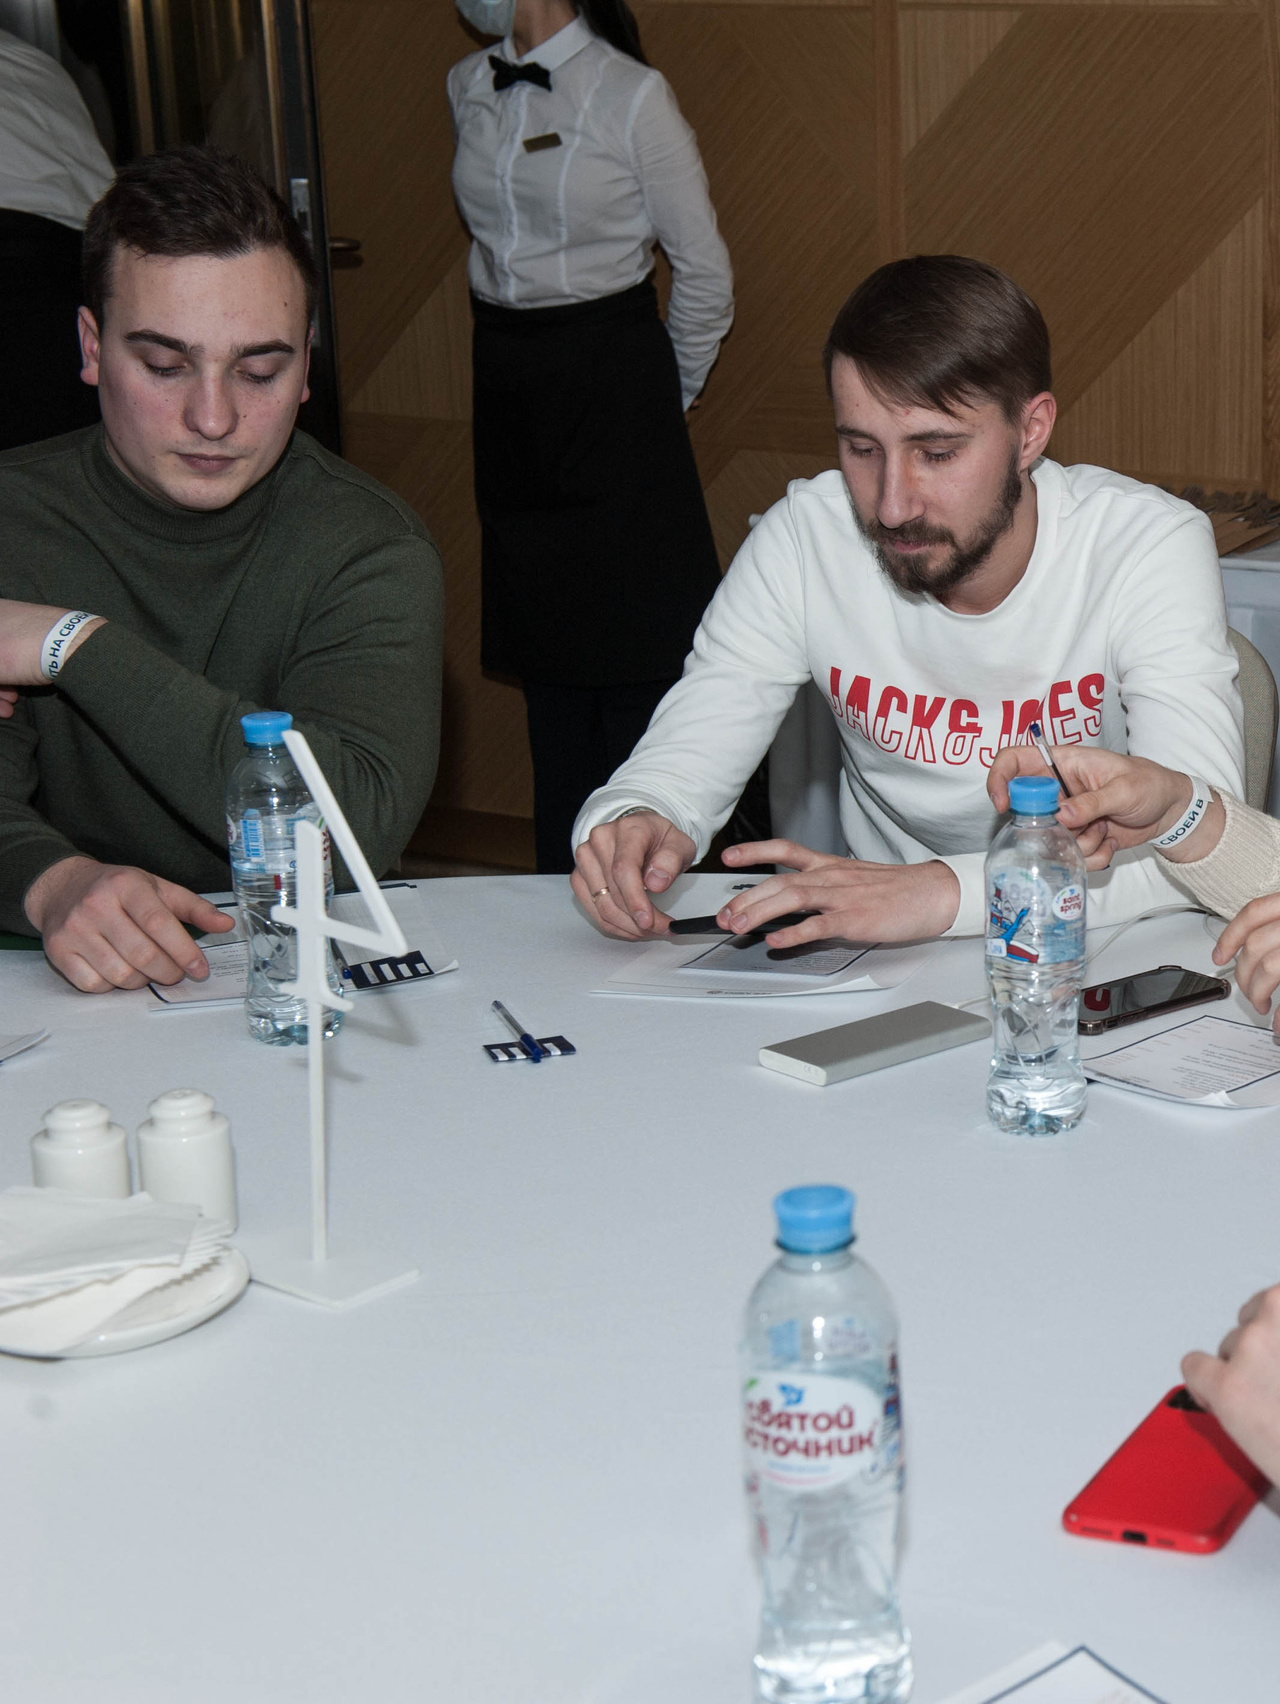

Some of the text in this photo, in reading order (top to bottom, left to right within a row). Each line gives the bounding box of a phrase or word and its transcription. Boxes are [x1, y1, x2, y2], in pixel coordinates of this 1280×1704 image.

[49, 640, 65, 658] НА
[827, 666, 1105, 769] JACK&JES
[1160, 811, 1199, 845] СВОЕЙ
